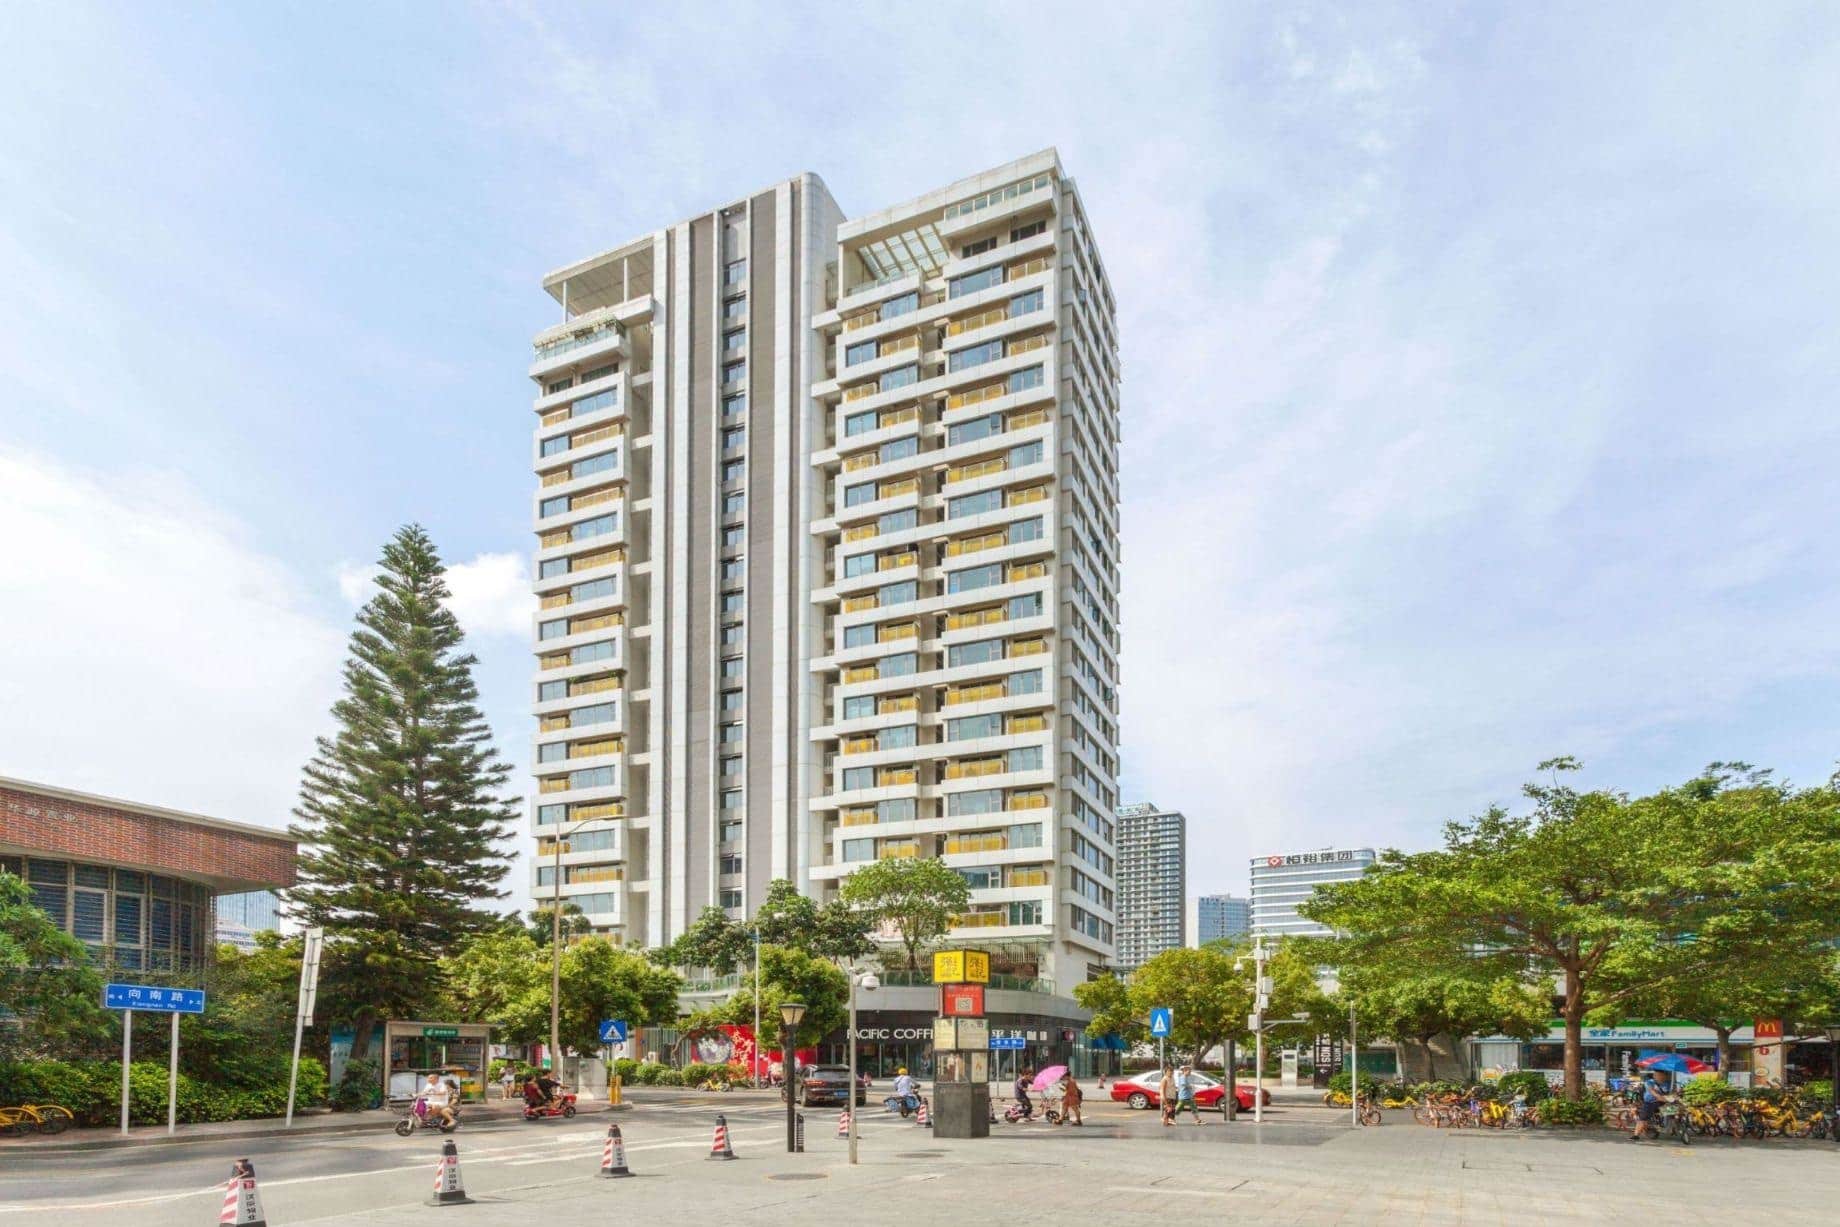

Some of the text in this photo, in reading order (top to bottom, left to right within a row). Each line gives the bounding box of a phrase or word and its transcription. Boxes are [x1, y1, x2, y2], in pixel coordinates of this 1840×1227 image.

[128, 989, 183, 1002] 向南路
[1611, 1029, 1664, 1038] FamilyMart
